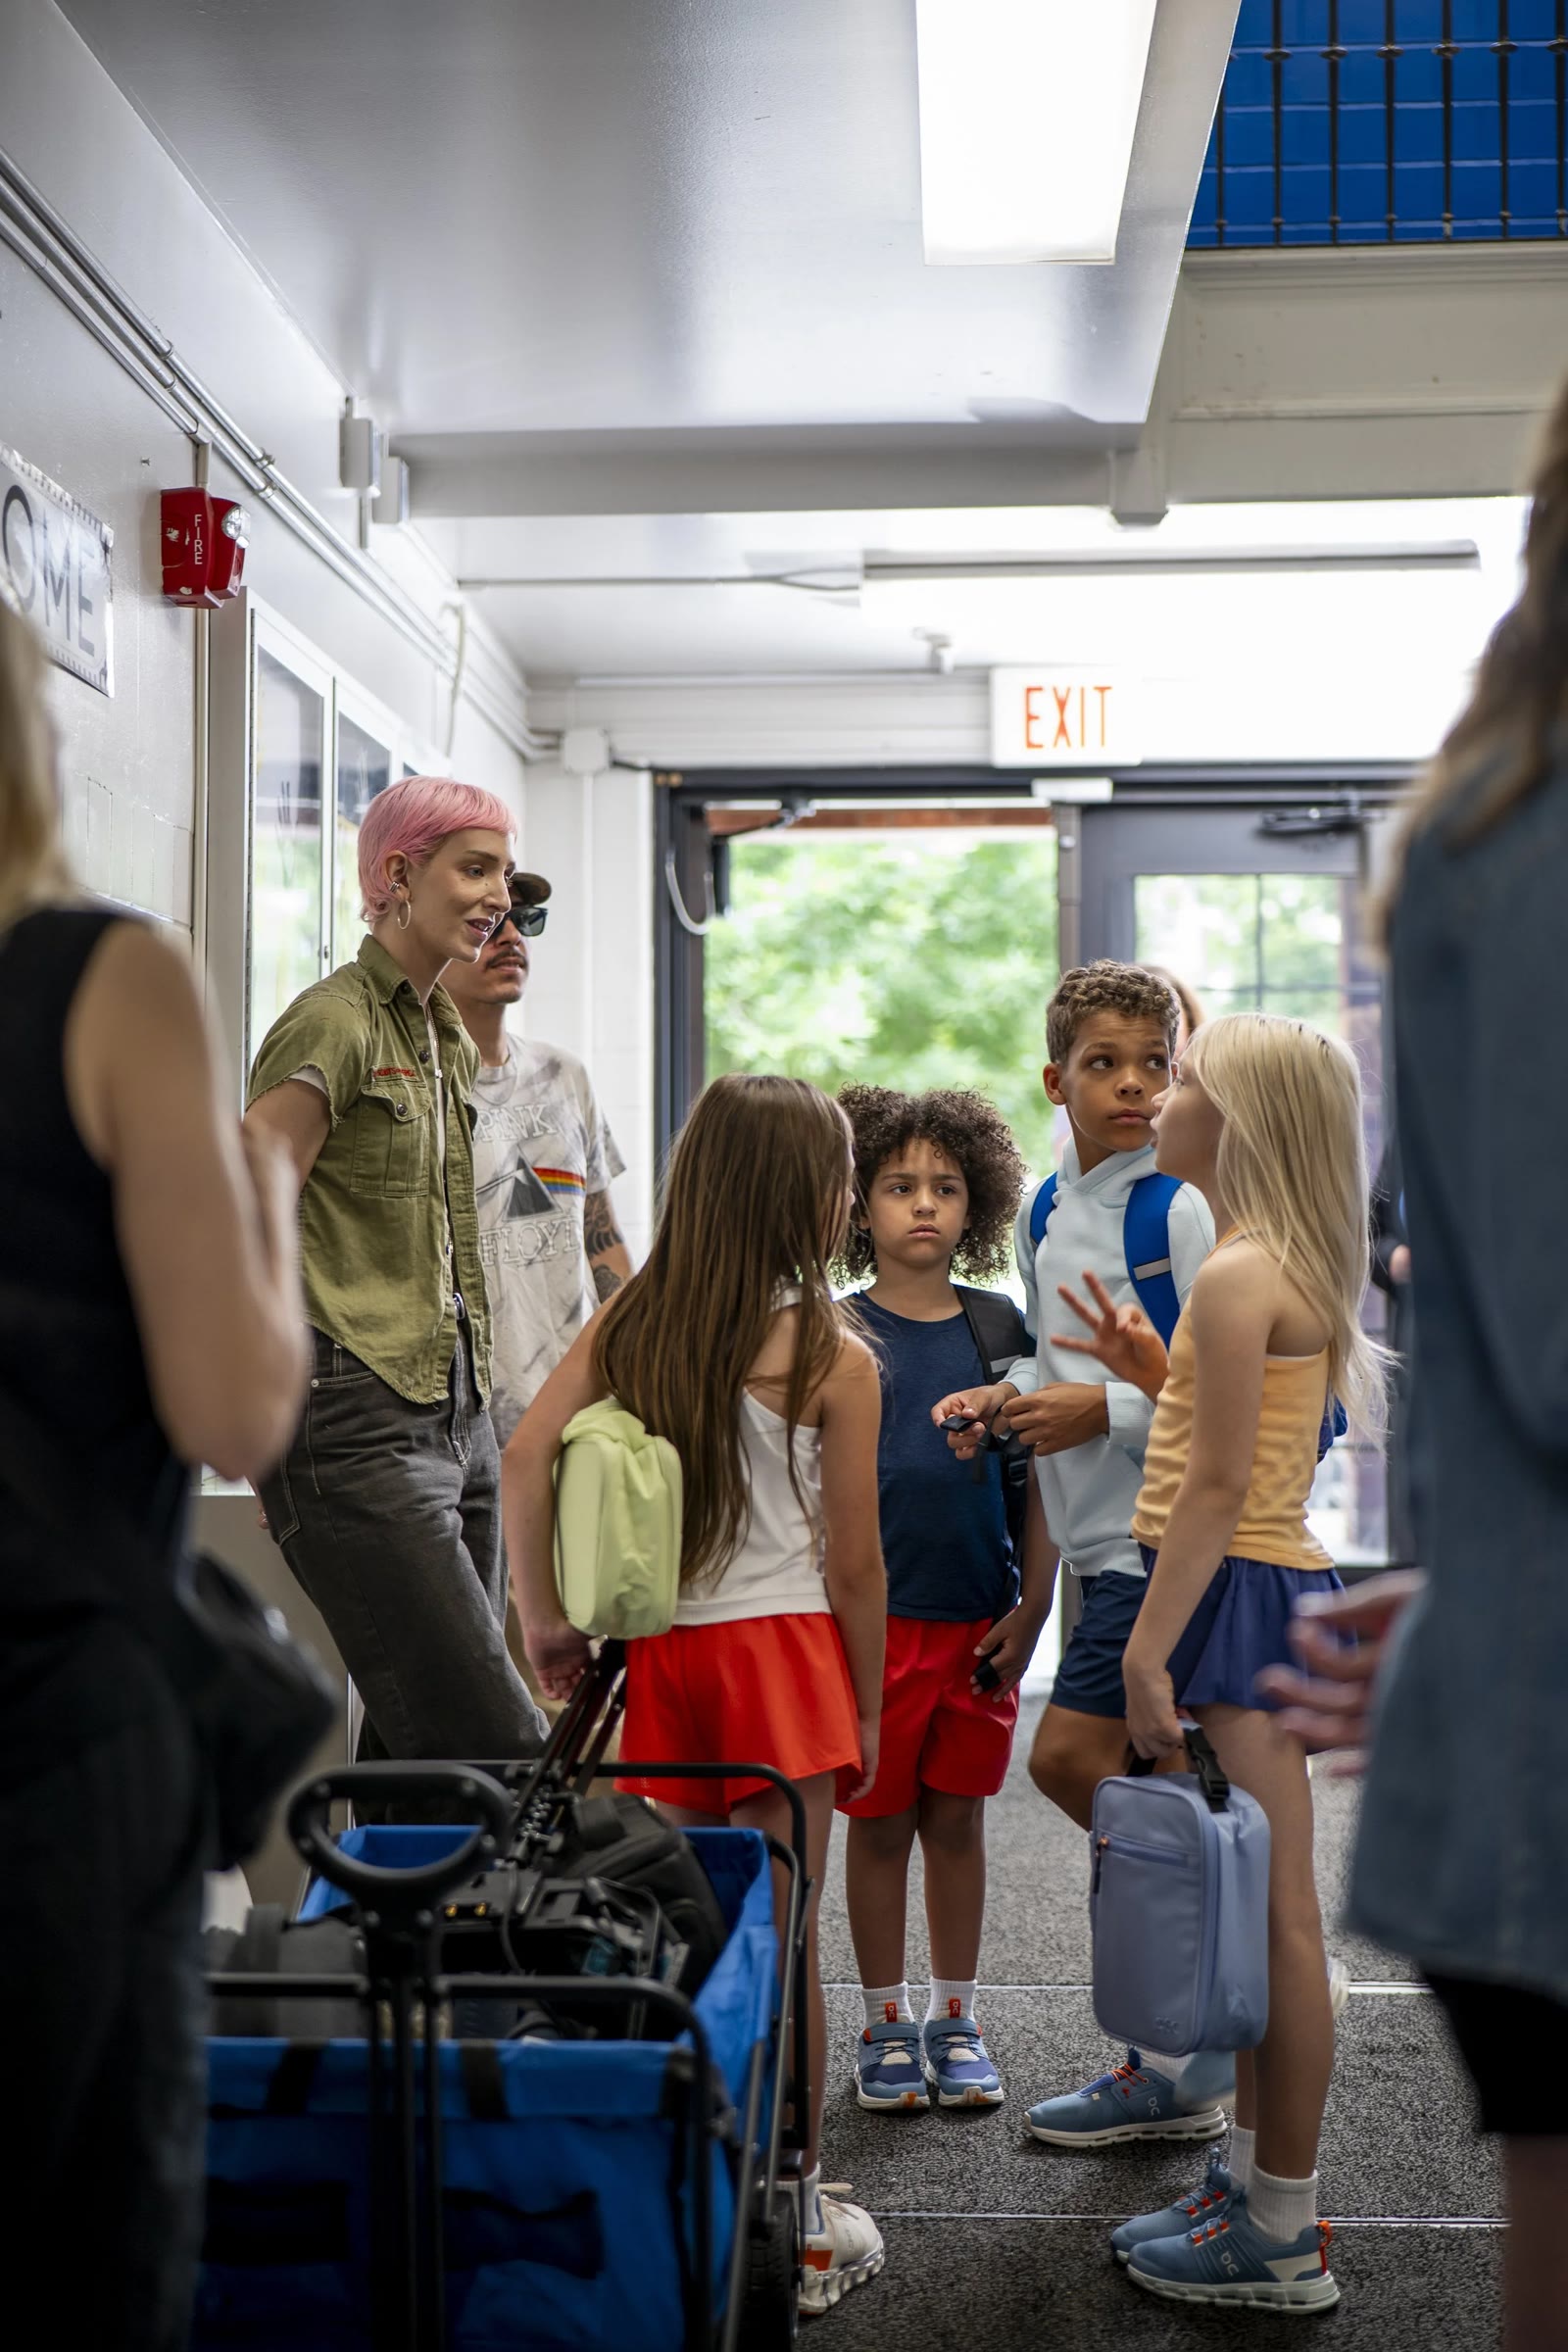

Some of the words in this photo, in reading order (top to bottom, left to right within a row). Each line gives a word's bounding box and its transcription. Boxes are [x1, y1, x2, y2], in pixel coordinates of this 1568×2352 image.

[194, 514, 203, 565] FIRE
[1025, 686, 1112, 749] EXIT
[477, 1104, 558, 1141] PINK
